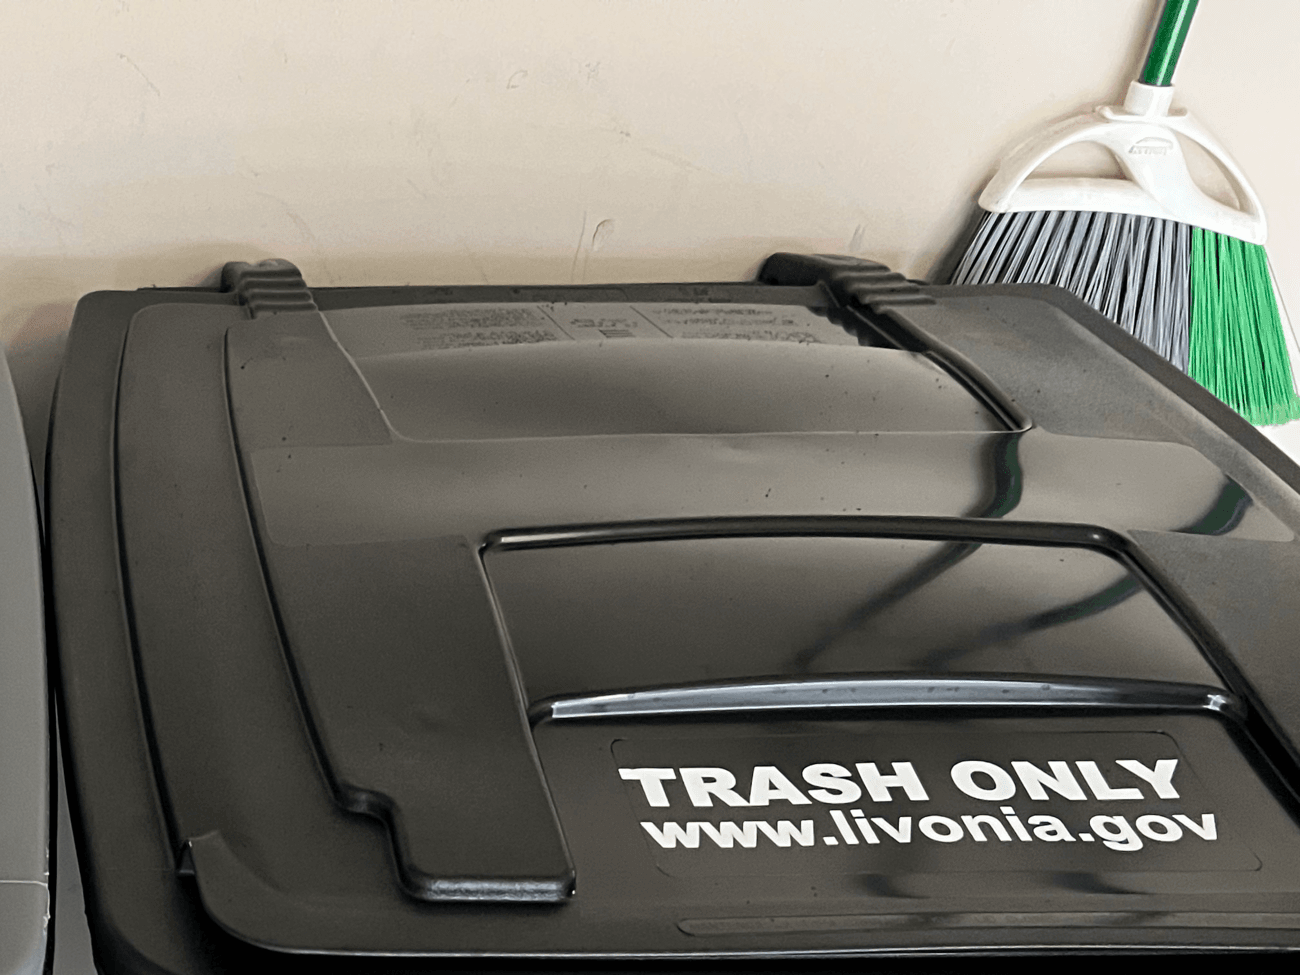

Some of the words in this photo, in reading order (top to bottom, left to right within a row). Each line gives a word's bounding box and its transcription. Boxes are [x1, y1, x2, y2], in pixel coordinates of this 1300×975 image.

[618, 761, 930, 807] TRASH
[950, 758, 1181, 802] ONLY
[639, 806, 1218, 852] www.livonia.gov
